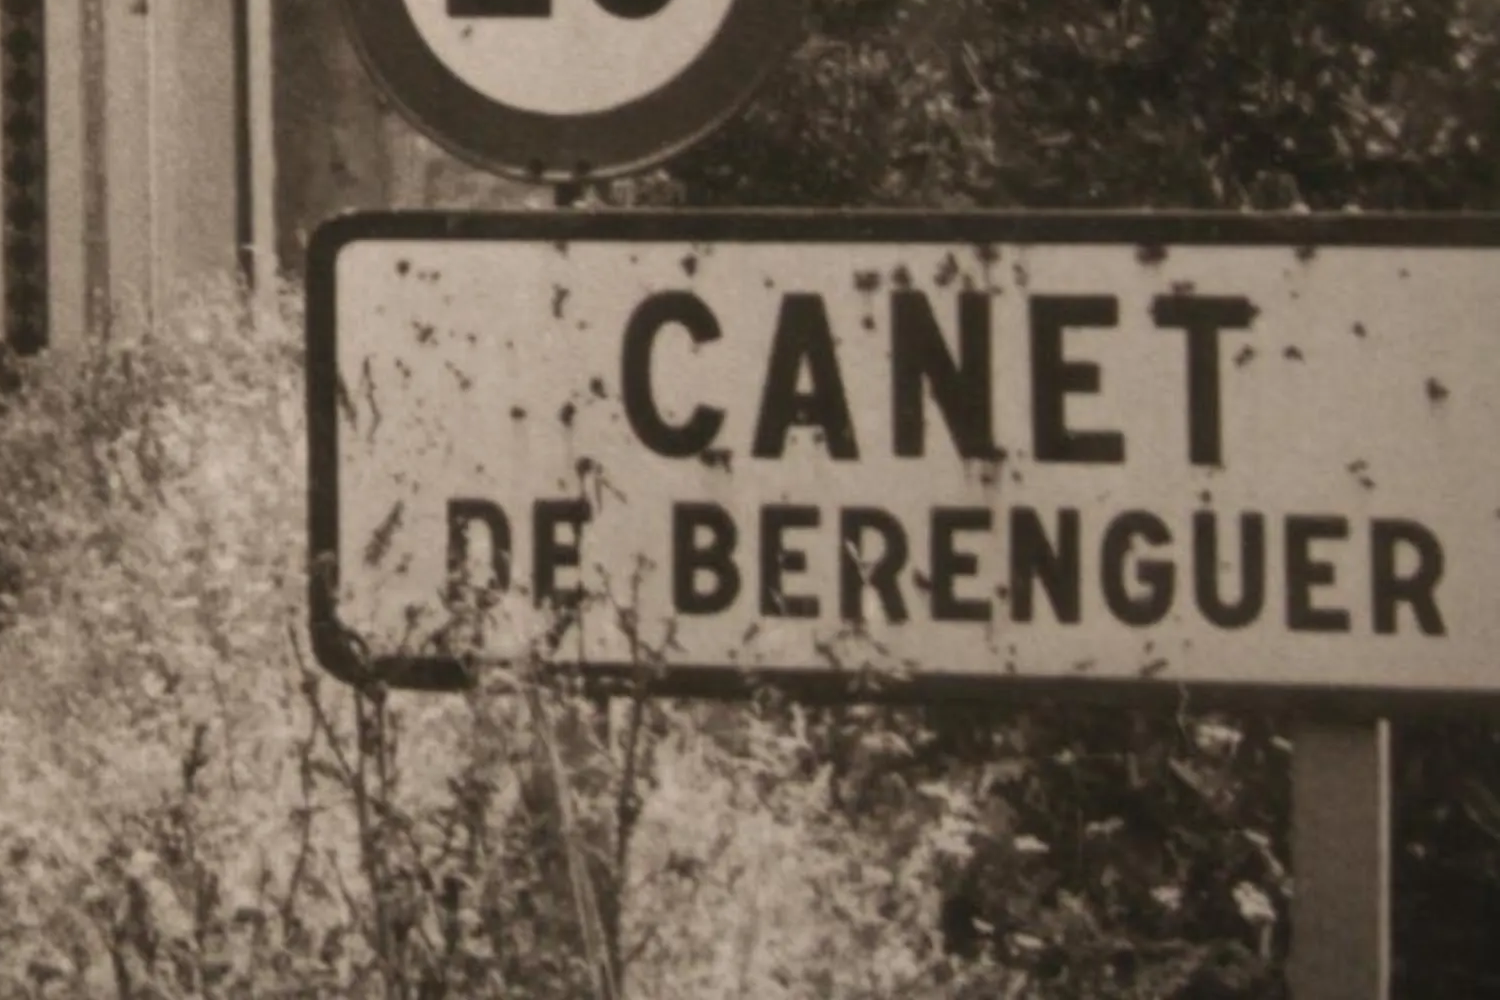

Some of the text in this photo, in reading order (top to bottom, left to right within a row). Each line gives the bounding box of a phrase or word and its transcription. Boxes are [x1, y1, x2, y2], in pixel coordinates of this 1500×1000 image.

[620, 290, 1256, 465] CANET
[447, 498, 1446, 636] DE BERENGUER
